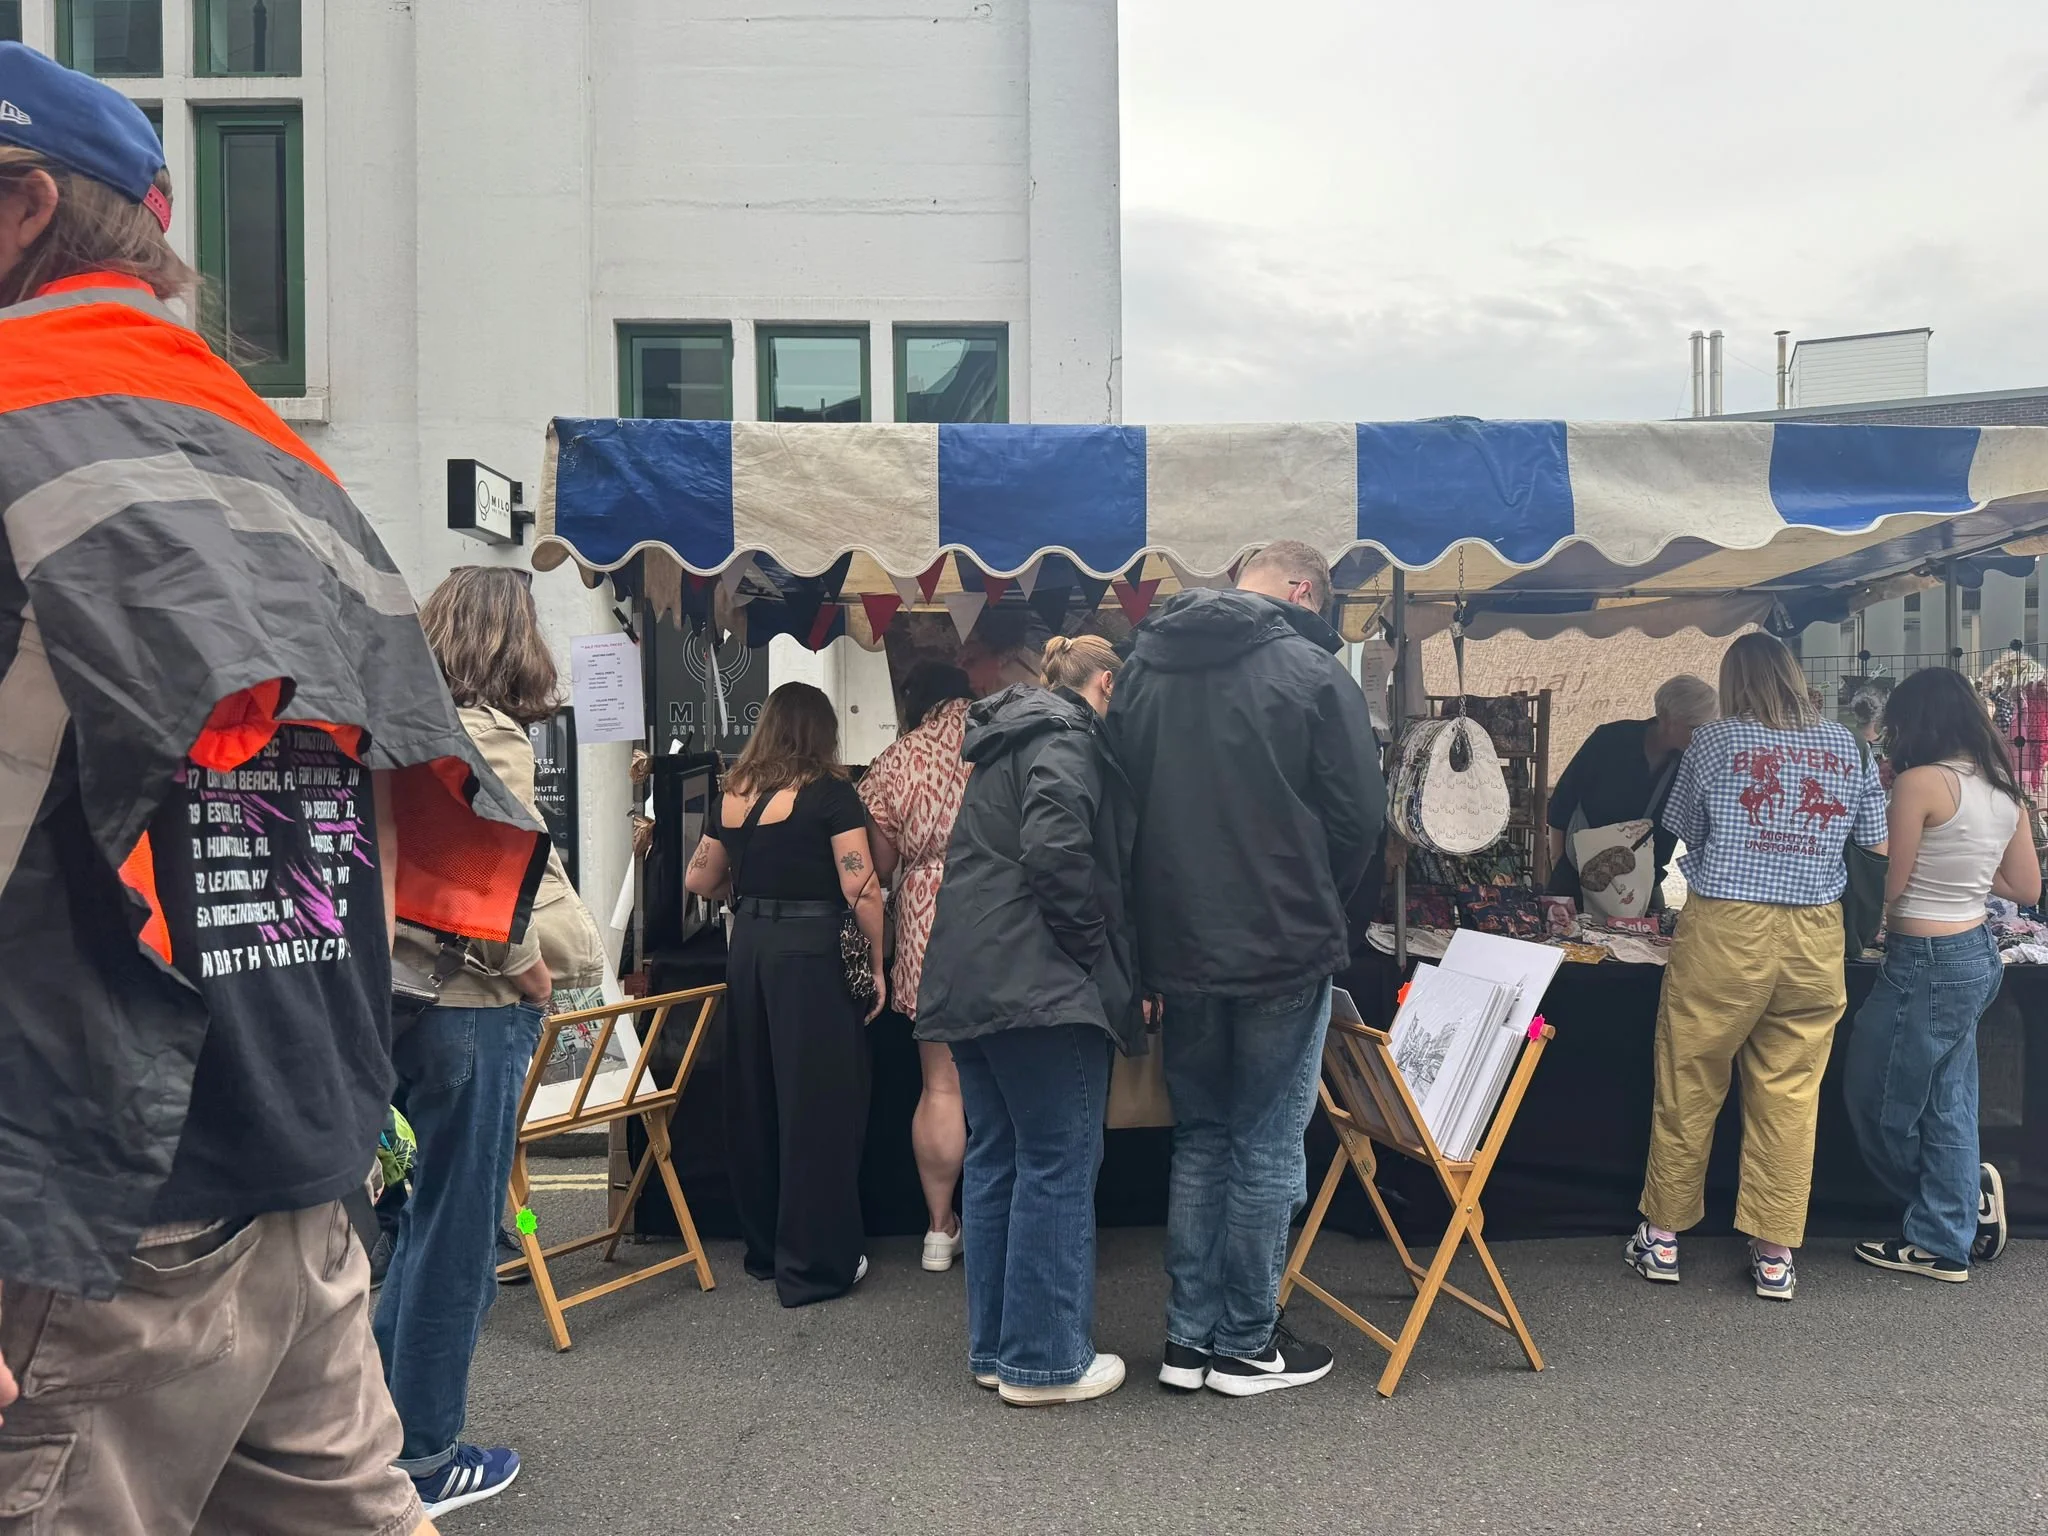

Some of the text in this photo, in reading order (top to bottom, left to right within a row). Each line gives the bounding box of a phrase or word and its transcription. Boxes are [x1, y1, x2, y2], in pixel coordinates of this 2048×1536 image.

[491, 495, 510, 512] MILO
[239, 769, 281, 793] BEACH,
[347, 767, 360, 787] IN
[534, 785, 558, 793] NUTE
[255, 836, 272, 857] AL
[340, 833, 354, 852] MI
[1760, 829, 1818, 846] MIGHTY &
[1744, 838, 1828, 858] UNSTOPPABLE
[252, 868, 269, 890] KY
[337, 866, 350, 885] WI
[201, 936, 346, 979] NORTH AMEICA
